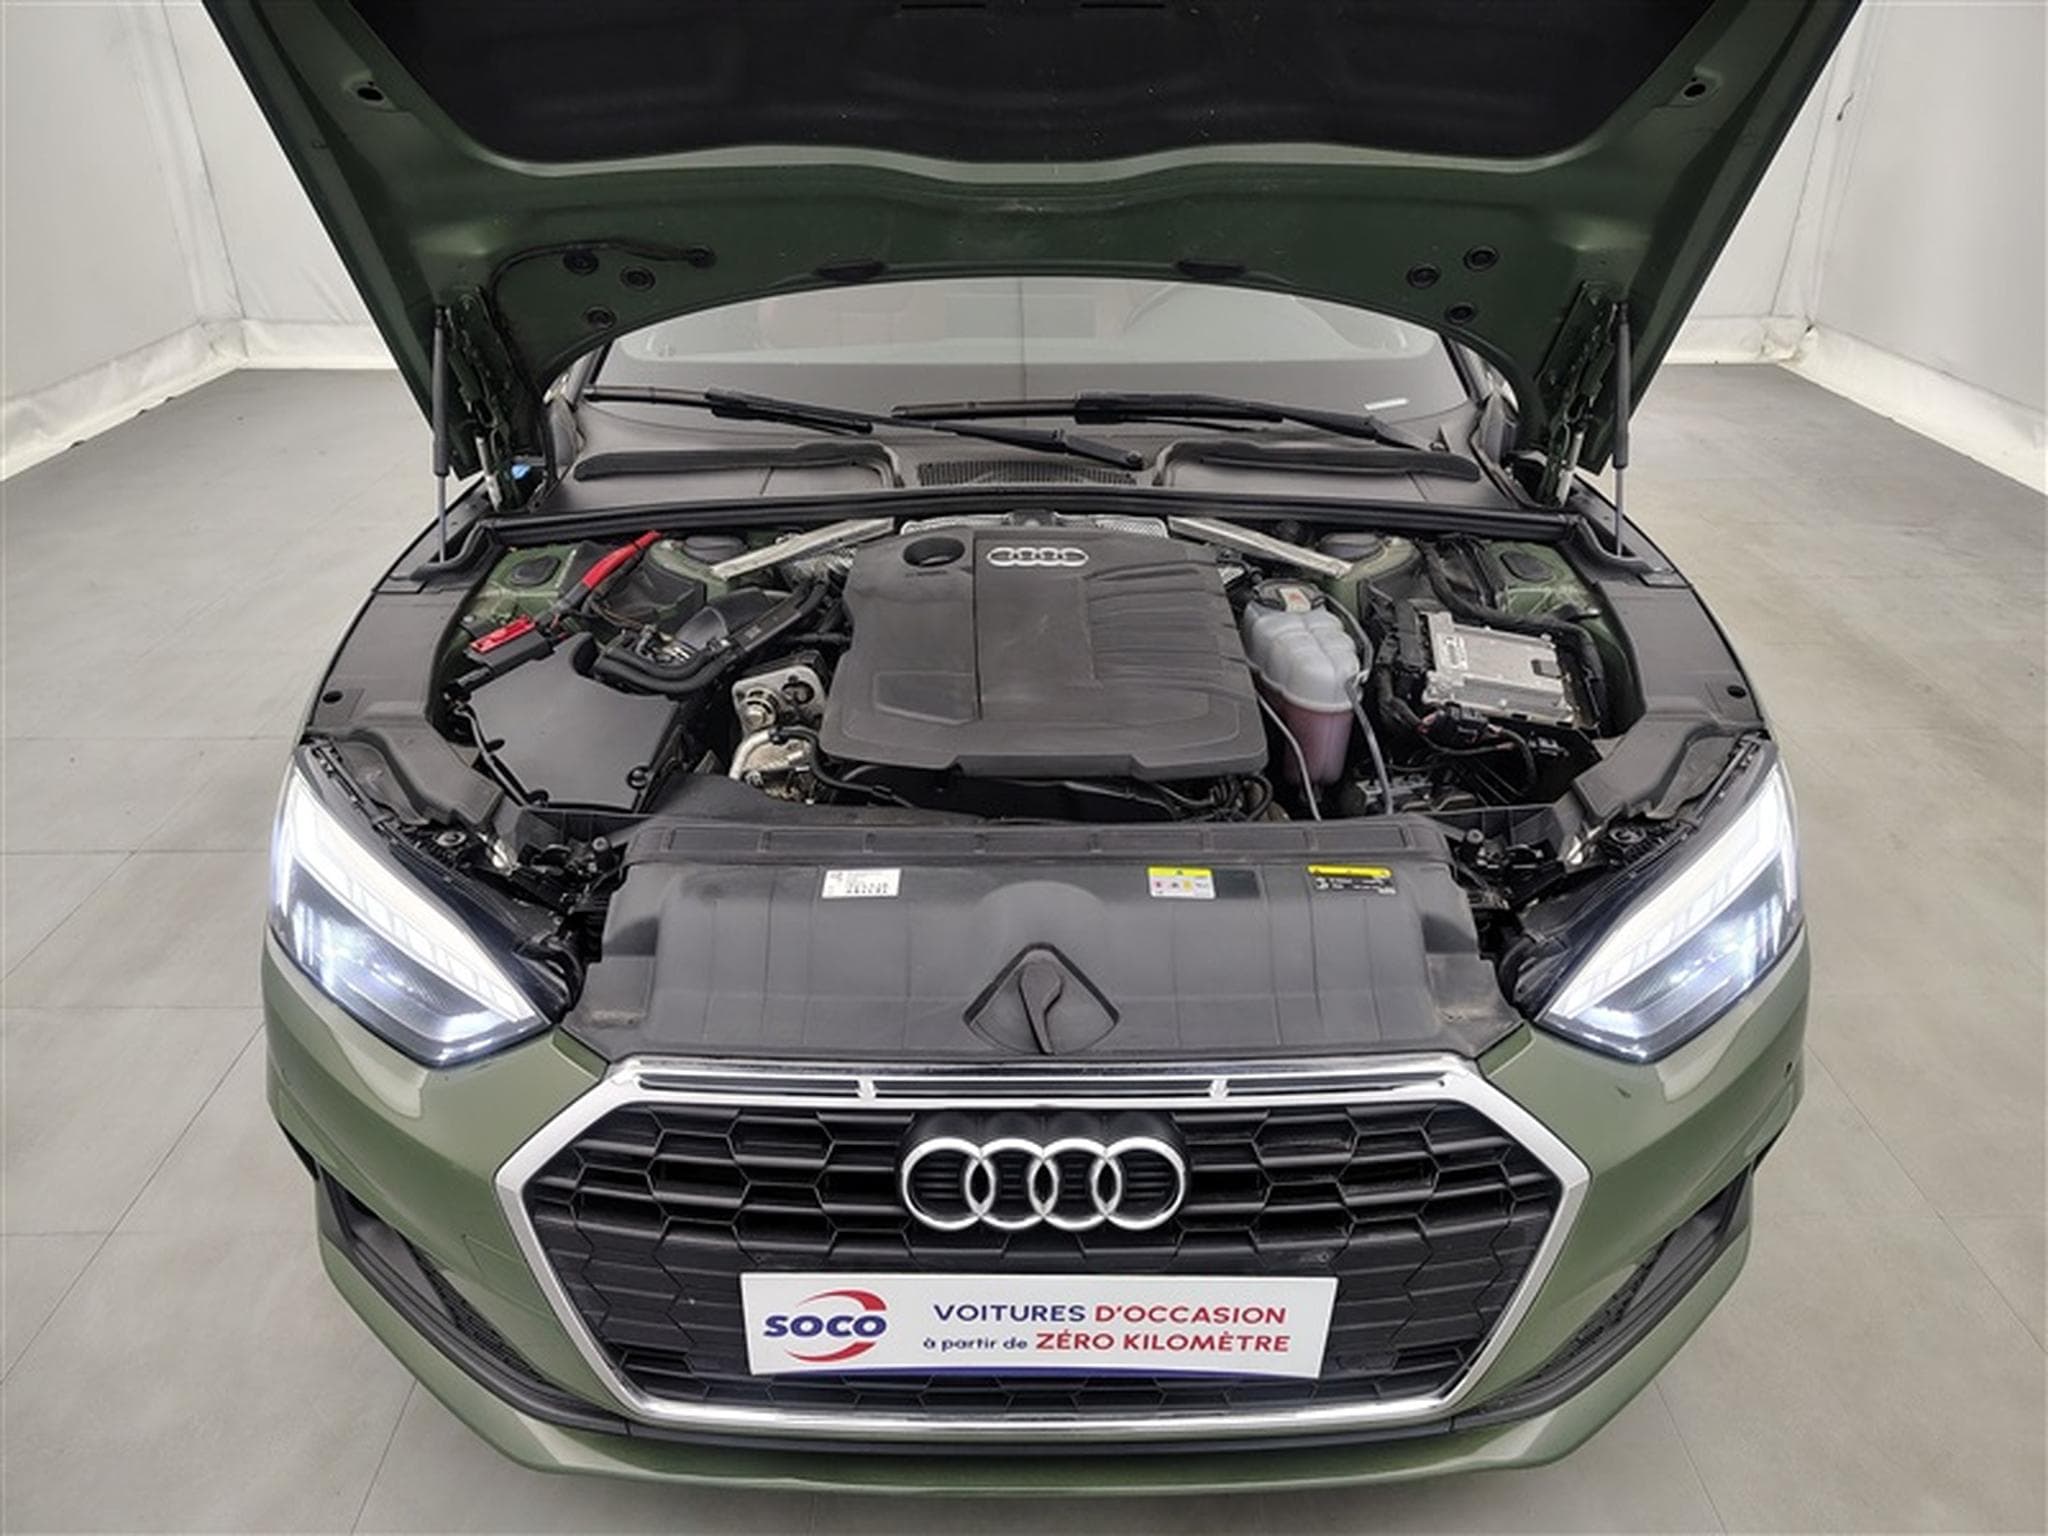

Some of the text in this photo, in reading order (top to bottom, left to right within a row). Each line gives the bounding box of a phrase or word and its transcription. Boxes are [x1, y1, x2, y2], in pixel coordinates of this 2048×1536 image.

[933, 1303, 1287, 1325] VOITURES D'OCCASION
[763, 1315, 888, 1338] SOCO
[923, 1328, 1291, 1352] à partir de ZÉRO KILOMÈTRE
